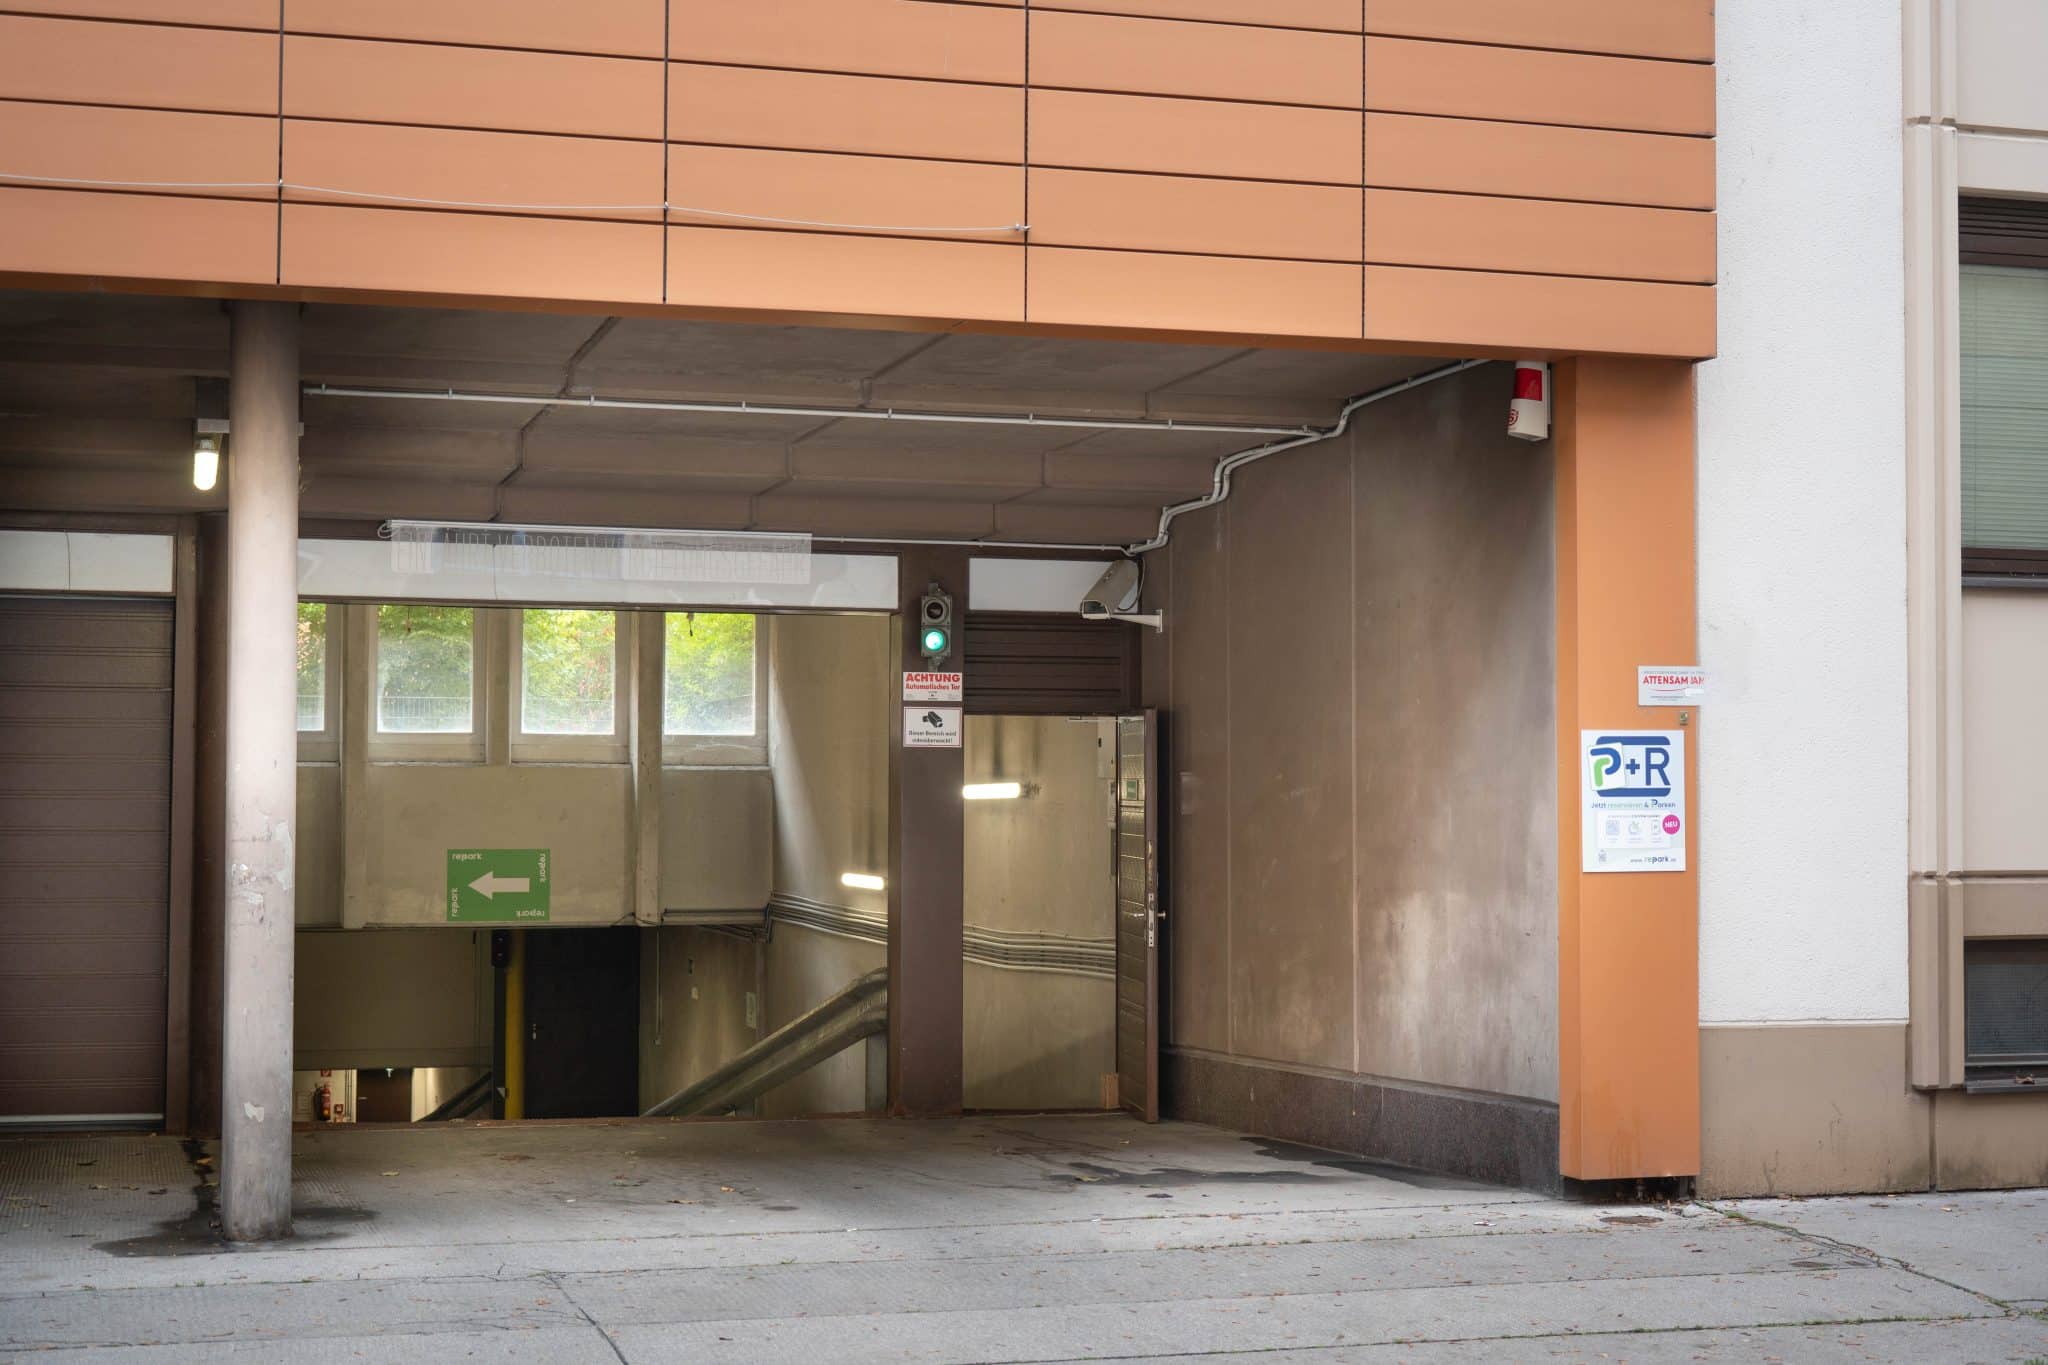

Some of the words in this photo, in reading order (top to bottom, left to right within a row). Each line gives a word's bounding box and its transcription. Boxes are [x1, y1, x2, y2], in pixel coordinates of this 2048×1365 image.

[905, 673, 960, 682] ACHTUNG
[1643, 675, 1688, 684] ATTENSAM
[1651, 799, 1676, 808] Parken
[452, 853, 482, 861] repark
[537, 853, 546, 882] repark
[451, 888, 460, 917] repark
[516, 908, 545, 916] repark
